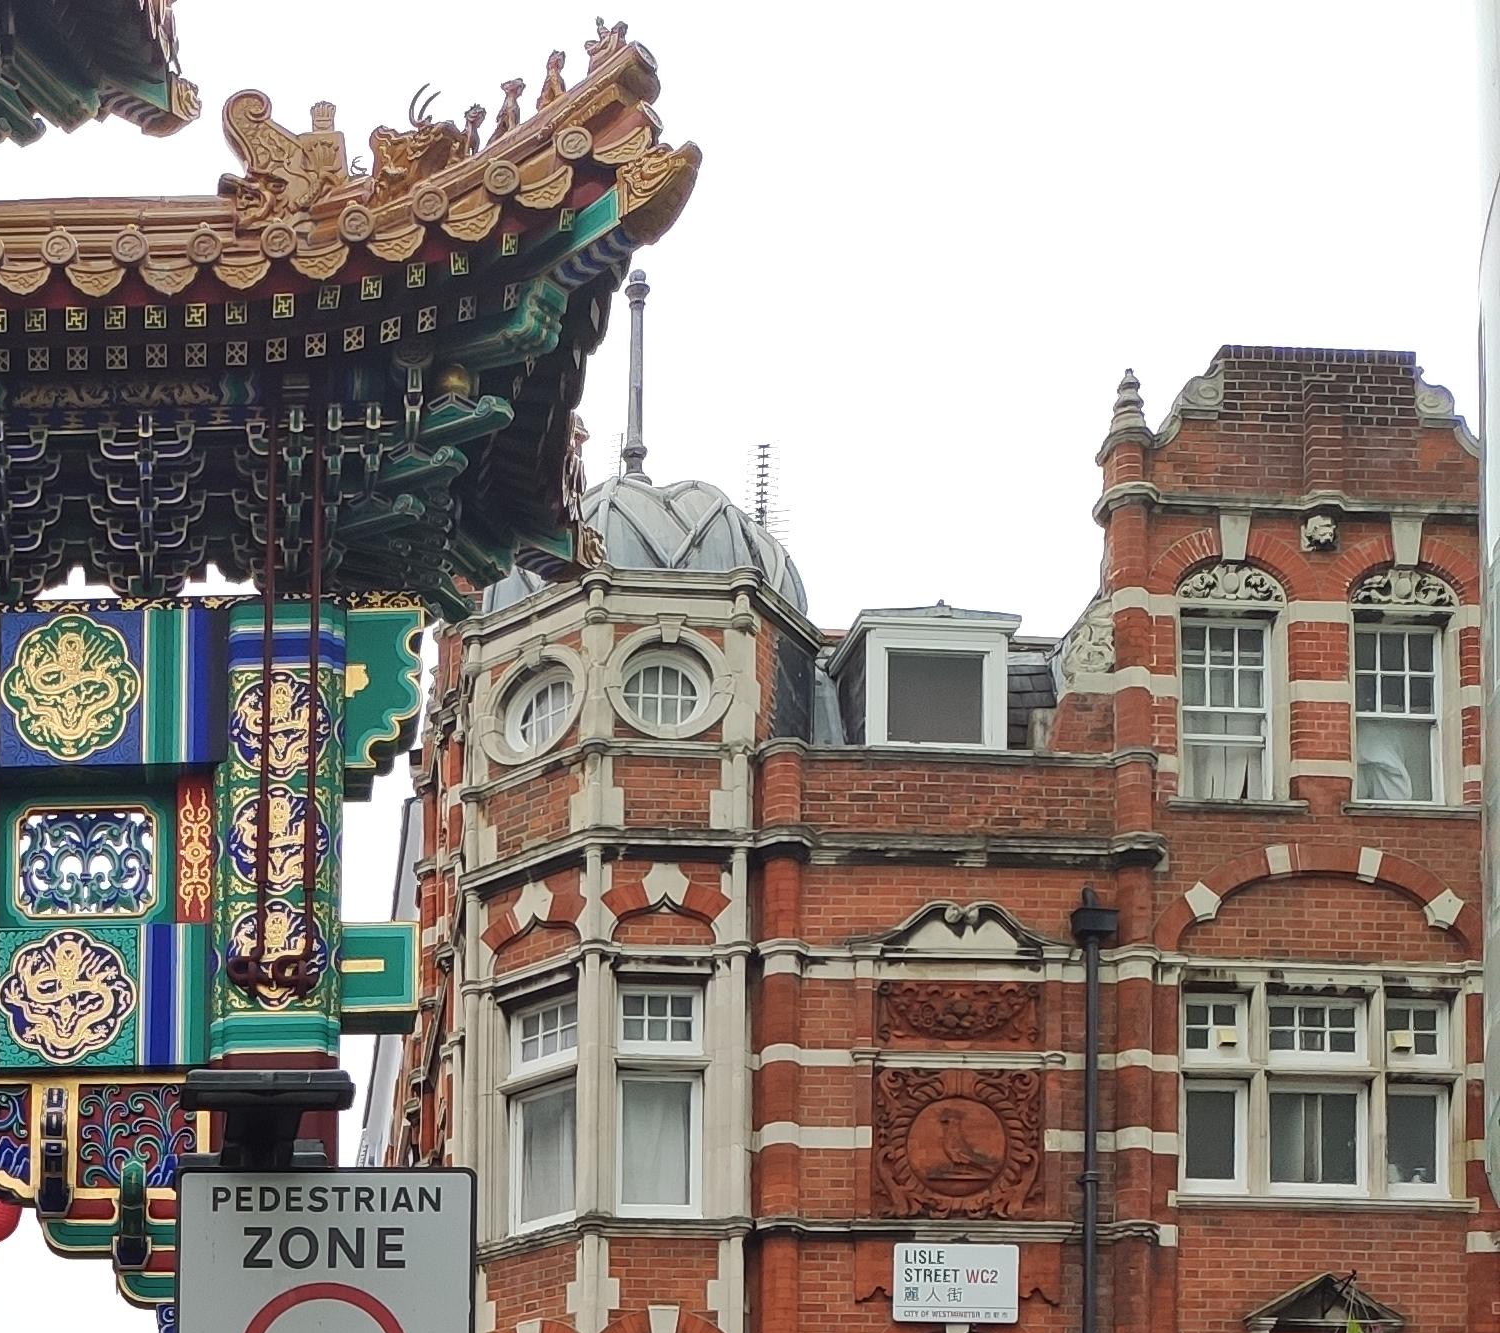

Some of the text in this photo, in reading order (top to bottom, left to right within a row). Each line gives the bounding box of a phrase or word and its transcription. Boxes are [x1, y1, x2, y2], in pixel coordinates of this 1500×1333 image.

[211, 1185, 443, 1214] PEDESTRIAN
[242, 1226, 407, 1270] ZONE
[904, 1249, 945, 1265] LISLE
[904, 1267, 998, 1284] STREET WC2
[903, 1310, 919, 1318] CITY
[920, 1310, 930, 1318] OF
